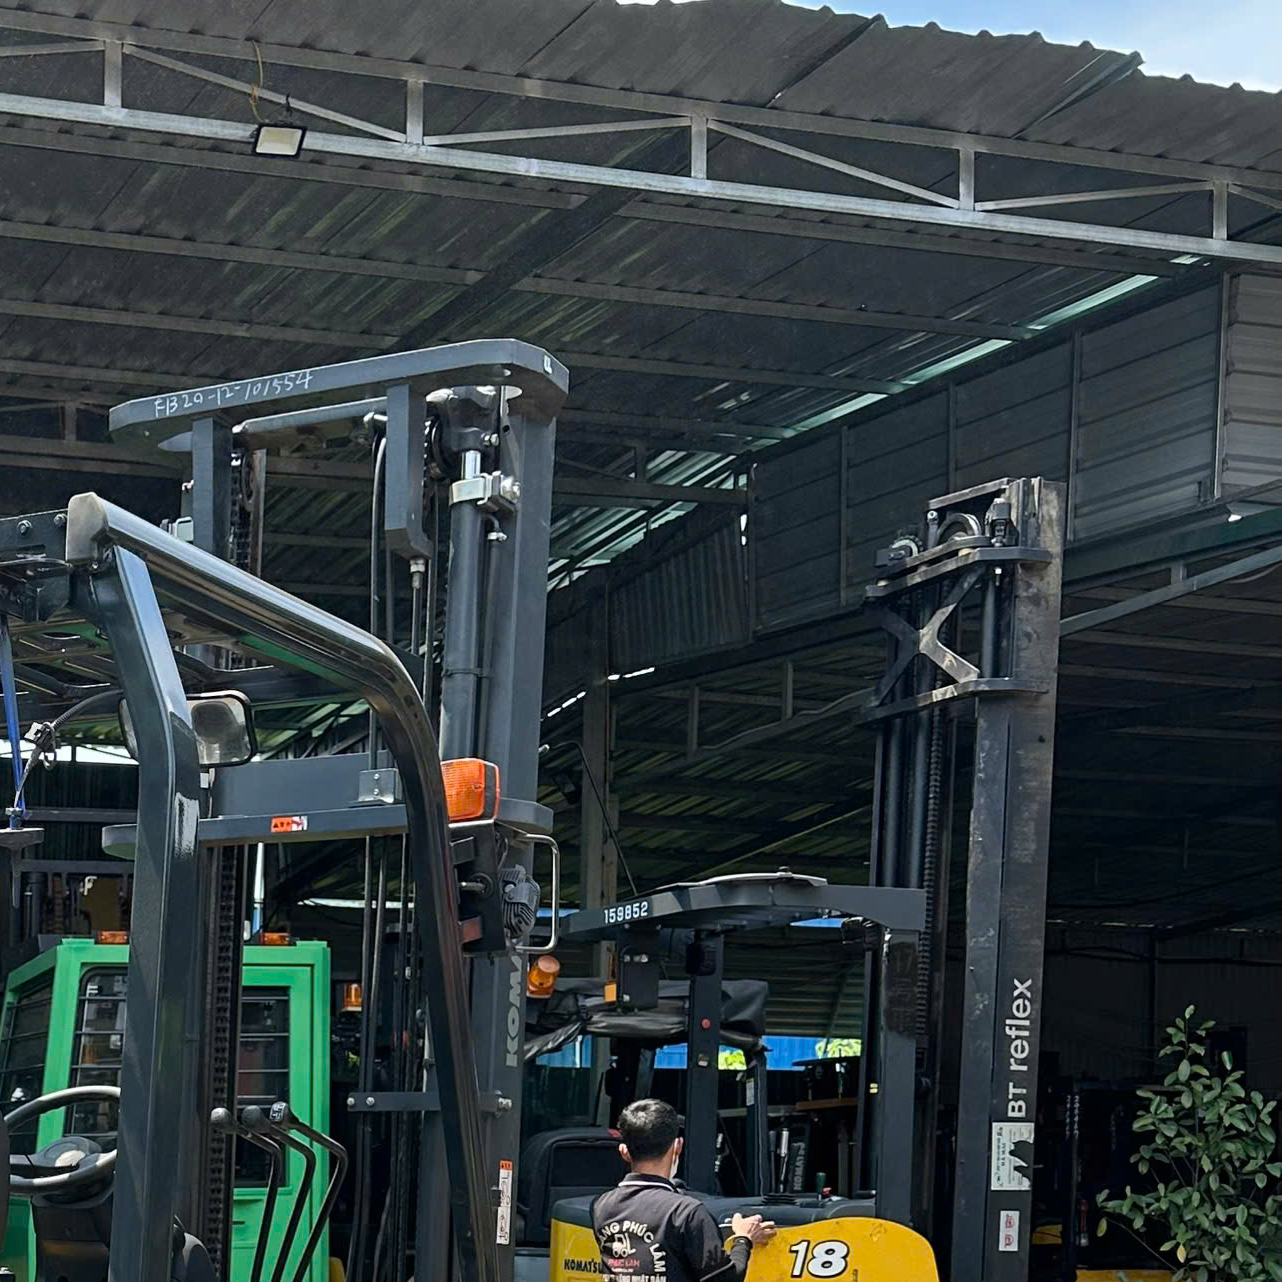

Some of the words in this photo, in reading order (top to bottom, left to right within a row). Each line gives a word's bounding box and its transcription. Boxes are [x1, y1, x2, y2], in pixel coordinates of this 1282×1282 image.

[604, 900, 649, 924] 159852
[1005, 977, 1033, 1072] reflex
[1007, 1082, 1027, 1118] BT
[622, 1220, 655, 1244] PHÚC
[649, 1243, 667, 1273] LÂM
[788, 1239, 851, 1279] 18
